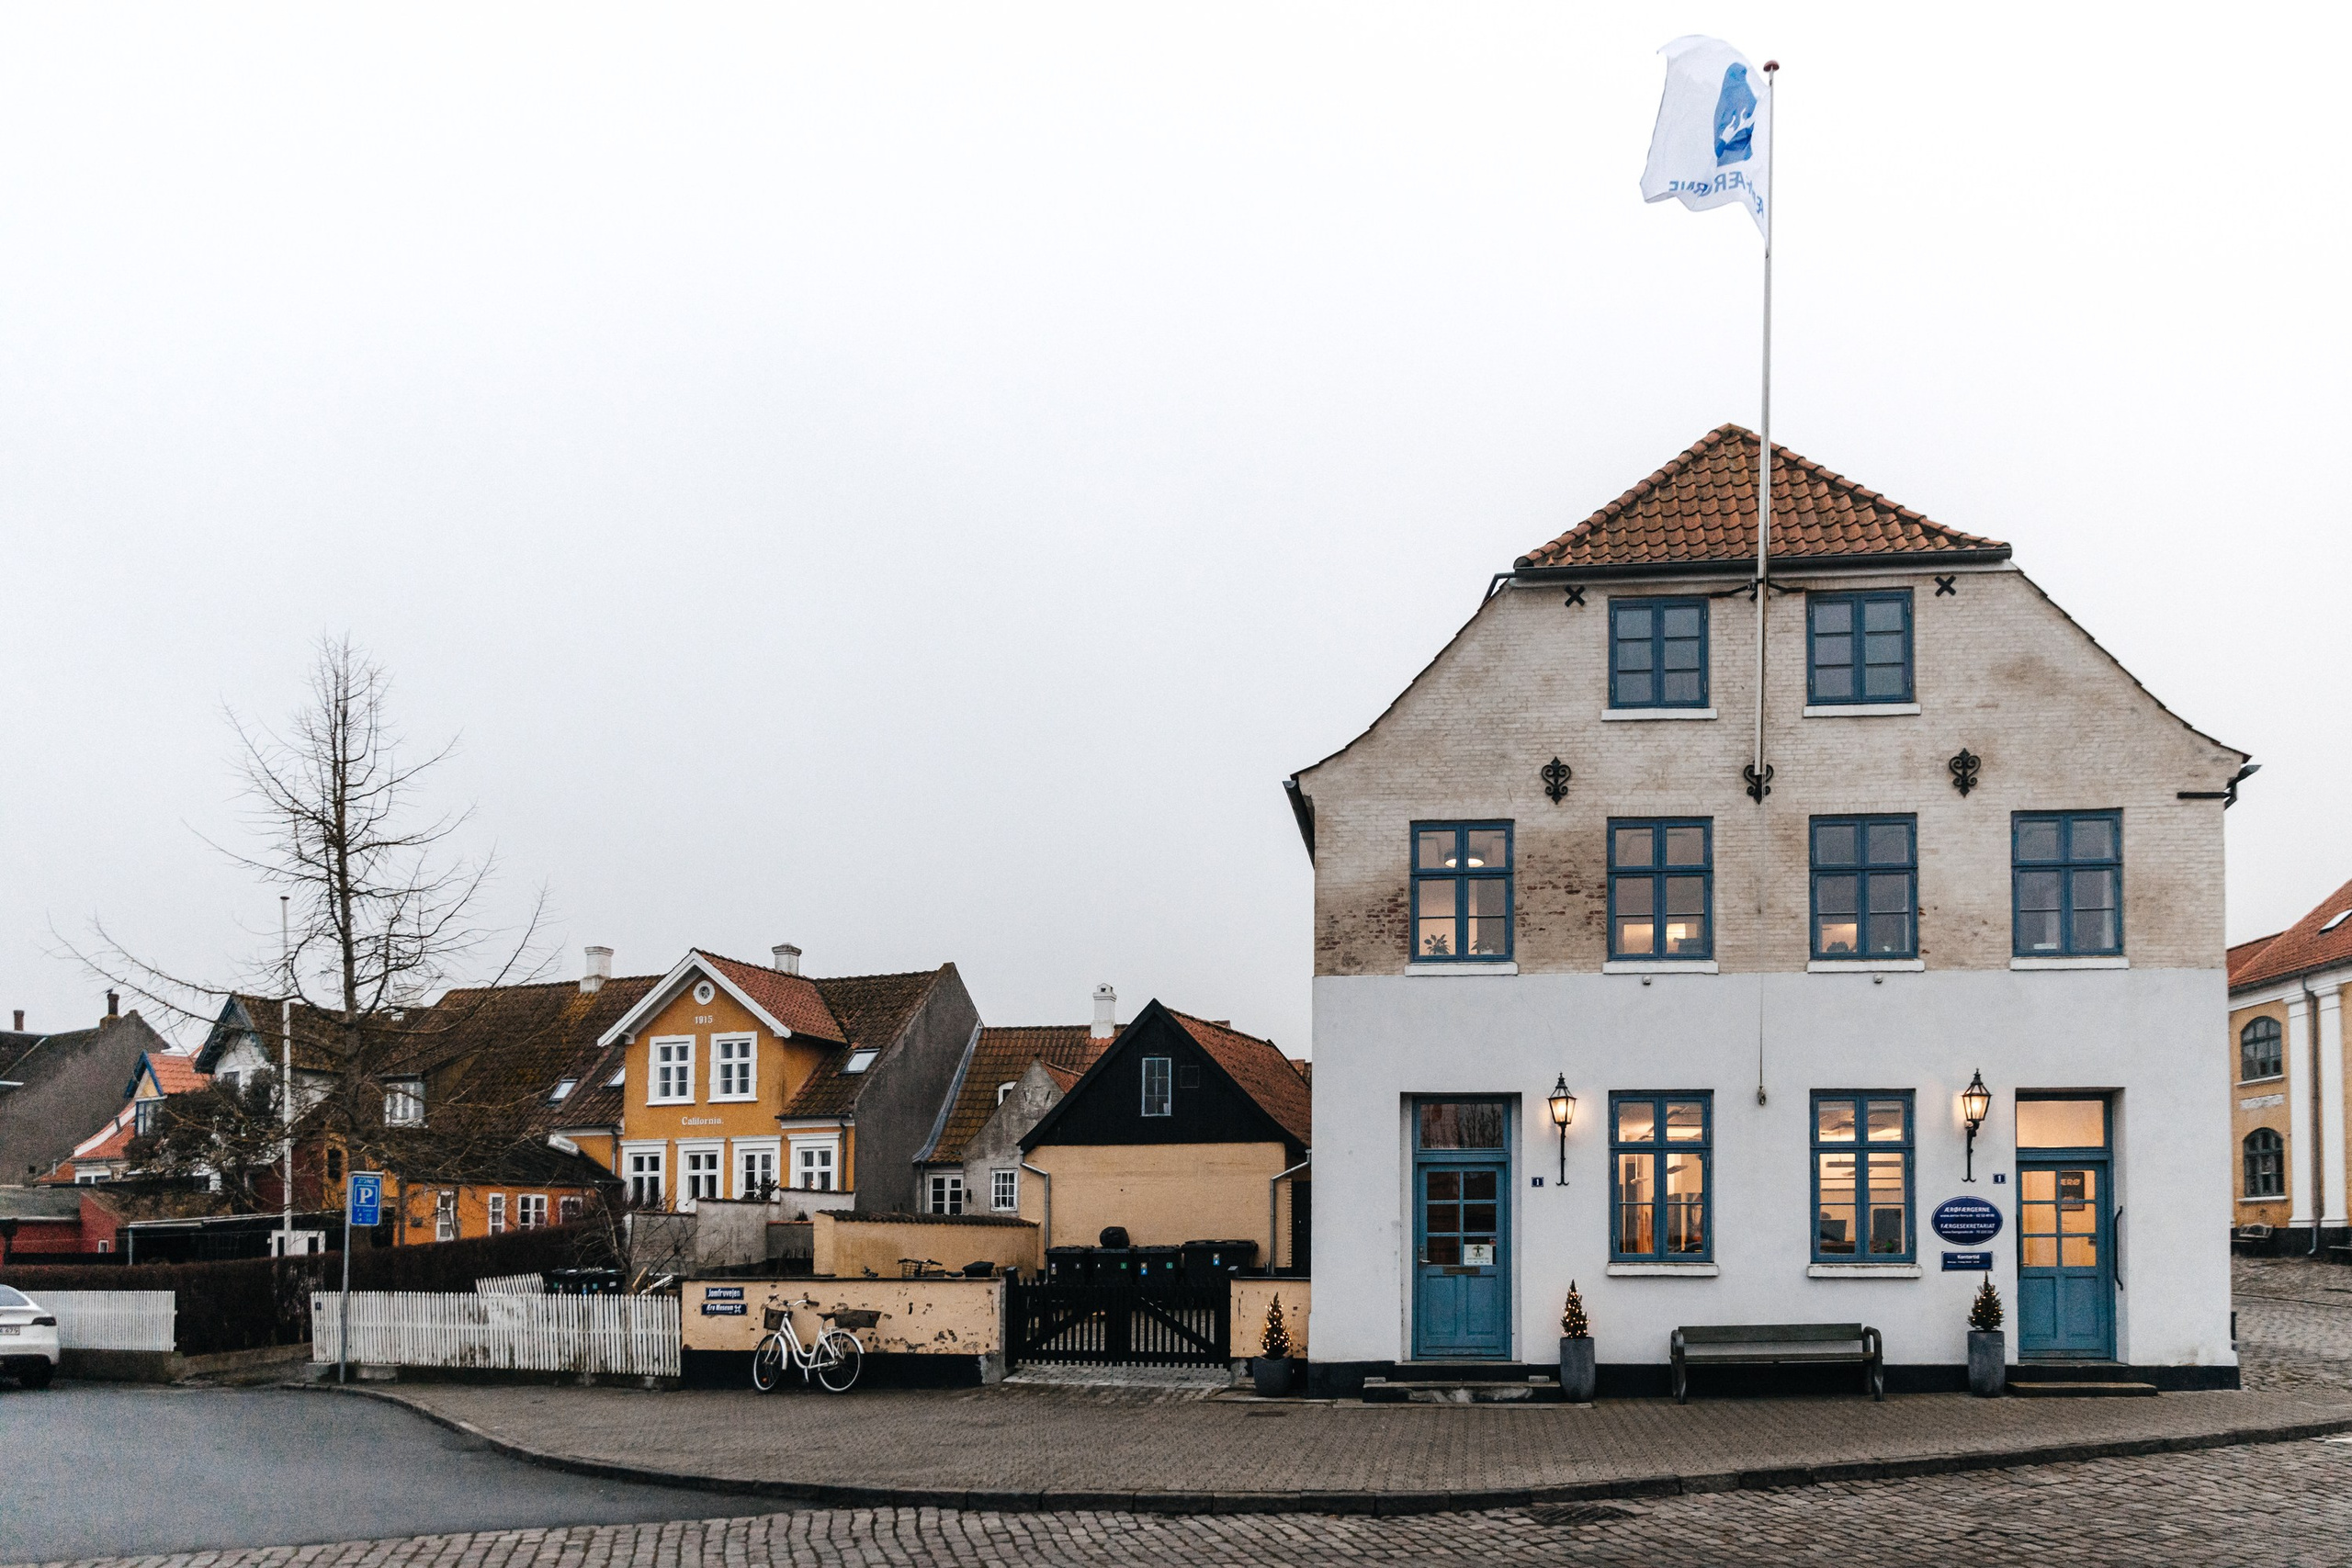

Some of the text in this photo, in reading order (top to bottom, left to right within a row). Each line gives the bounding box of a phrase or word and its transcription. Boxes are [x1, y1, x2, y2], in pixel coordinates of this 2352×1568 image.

[694, 1015, 713, 1024] 1915
[359, 1188, 373, 1203] P
[707, 1288, 741, 1298] Jomfruvejen
